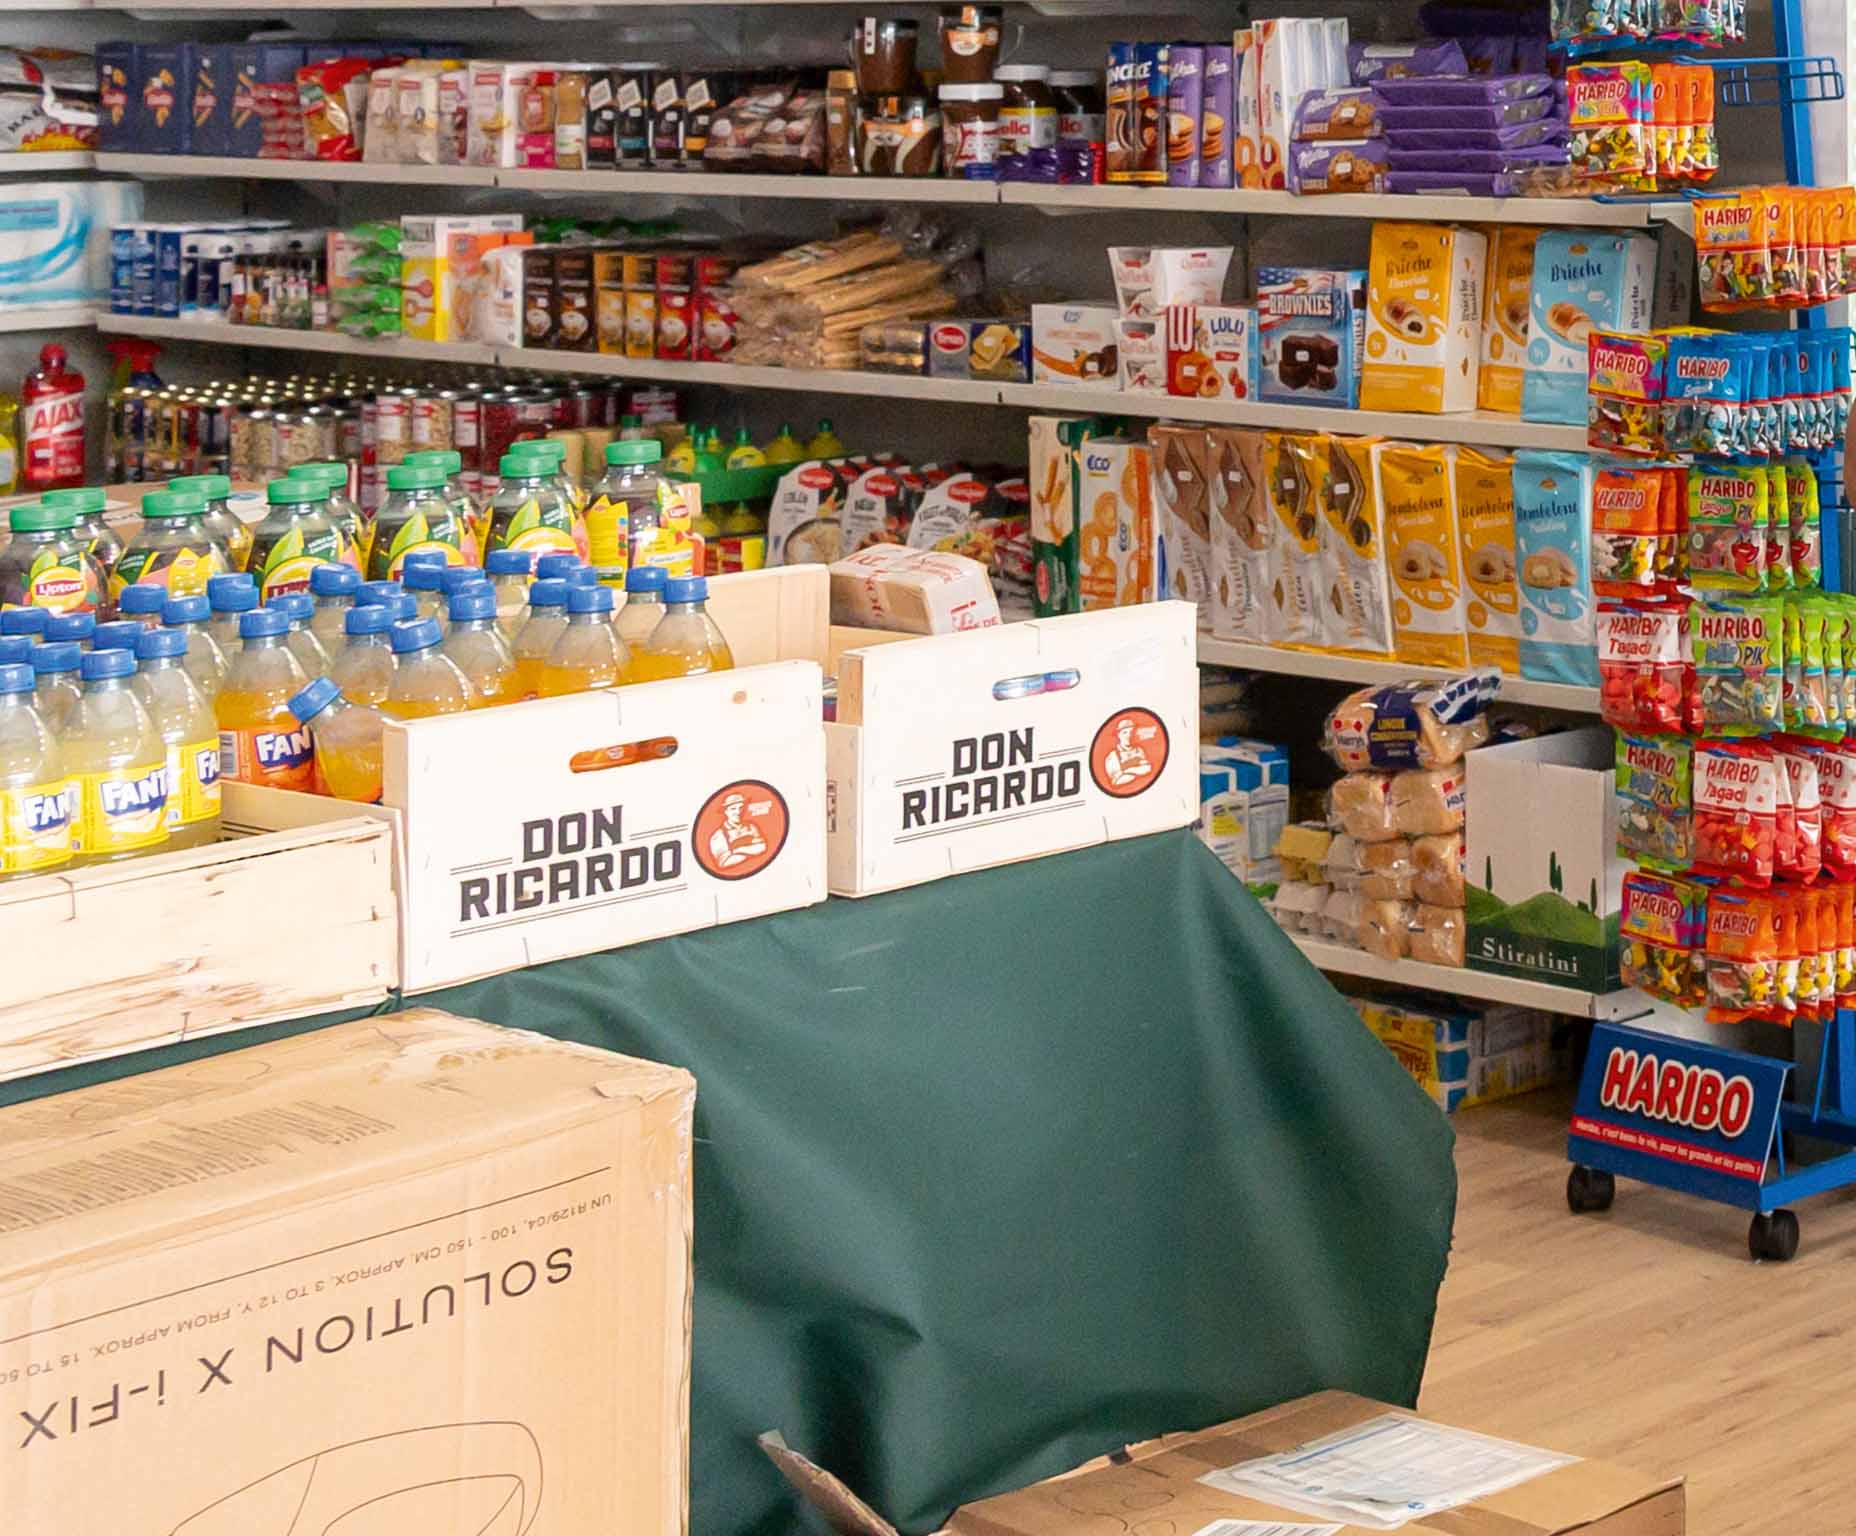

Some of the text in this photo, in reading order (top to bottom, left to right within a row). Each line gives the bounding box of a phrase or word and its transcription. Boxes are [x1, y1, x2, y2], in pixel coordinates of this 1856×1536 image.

[1577, 80, 1626, 101] HARIBO
[1704, 206, 1752, 227] HARIBO
[1269, 292, 1332, 319] BROWNIES
[1168, 305, 1196, 352] LU
[1211, 317, 1244, 336] LULU
[1595, 350, 1648, 375] HARIBO
[1678, 356, 1728, 378] HARIBO
[32, 399, 83, 432] AJAX
[1599, 488, 1645, 510] HARIBO
[1700, 478, 1757, 499] HARIBO
[35, 580, 84, 597] Lipton
[1609, 615, 1662, 636] HARIBO
[1700, 617, 1764, 639] HARIBO
[952, 726, 1034, 778] DON
[1706, 758, 1759, 784] HARIBO
[902, 760, 1081, 830] RICARDO
[521, 805, 623, 863] DON
[459, 840, 682, 922] RICARDO
[1630, 894, 1681, 921] HARIBO
[1711, 911, 1758, 935] HARIBO
[1482, 937, 1579, 975] Stiratini
[1602, 1049, 1752, 1135] HARIBO
[590, 1193, 612, 1210] UN
[491, 1225, 518, 1242] 100
[447, 1239, 474, 1256] 150
[285, 1287, 310, 1303] TO
[315, 1281, 326, 1294] 3
[257, 1295, 278, 1310] 12
[177, 1307, 231, 1335] FROM
[20, 1246, 574, 1449] SOLUTION X i-FIX
[26, 1362, 54, 1378] TO
[59, 1352, 80, 1368] 15
